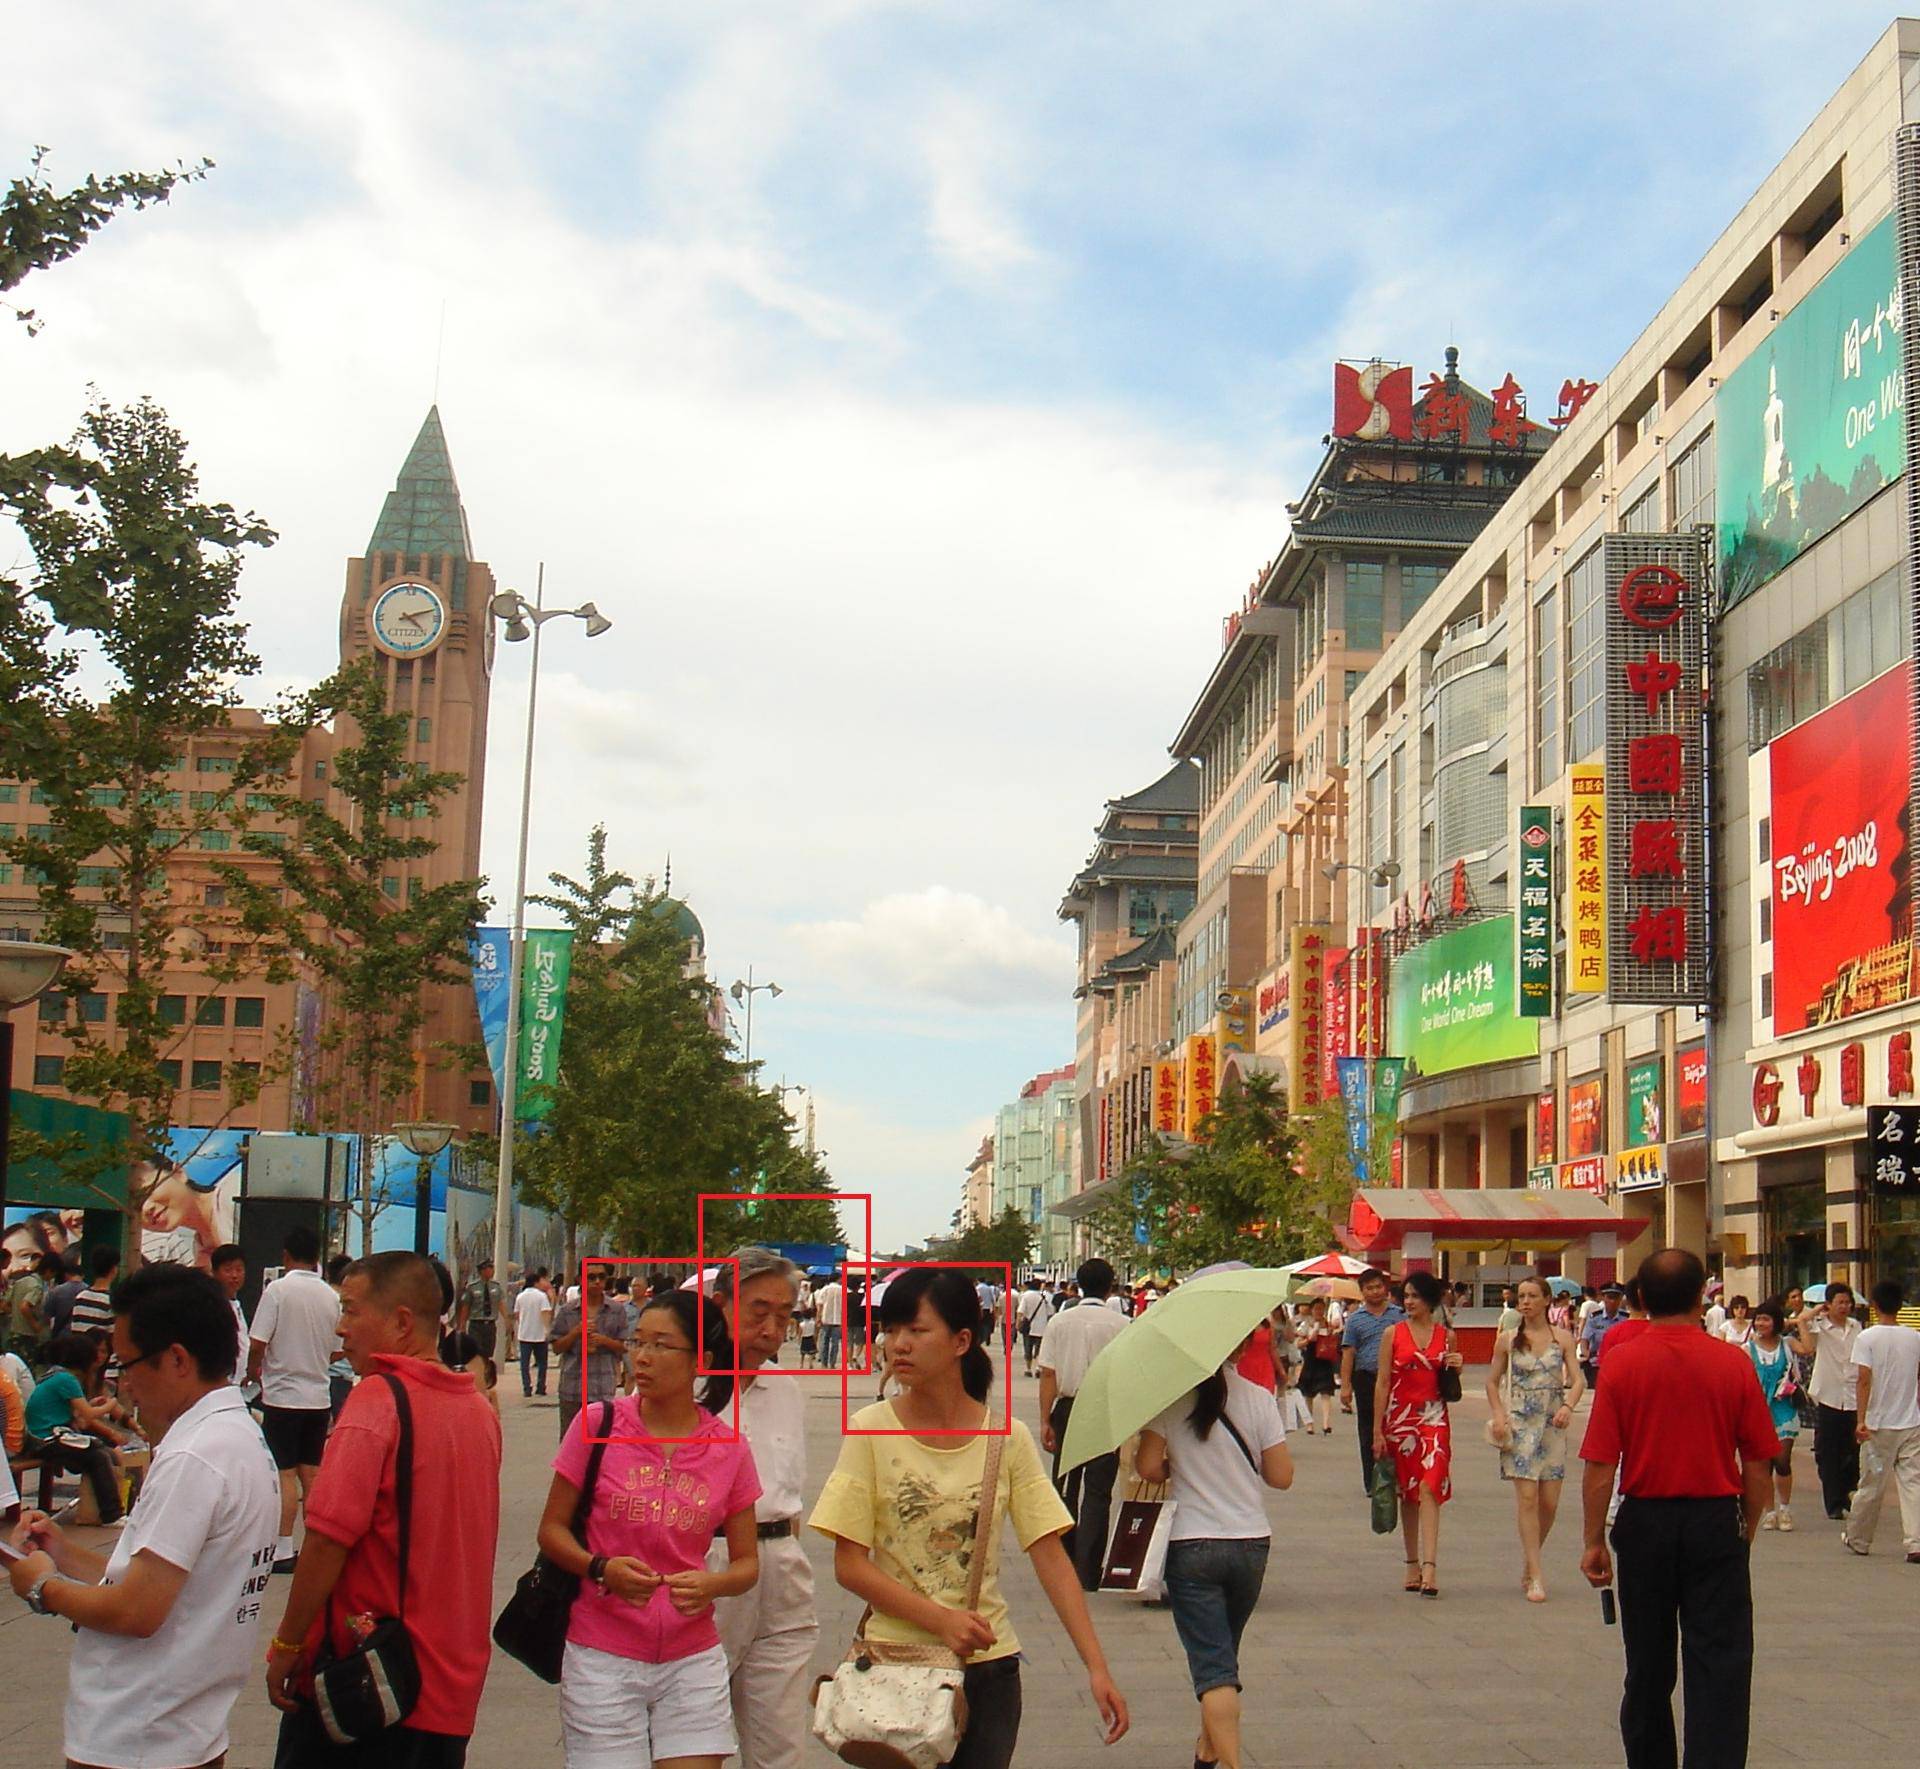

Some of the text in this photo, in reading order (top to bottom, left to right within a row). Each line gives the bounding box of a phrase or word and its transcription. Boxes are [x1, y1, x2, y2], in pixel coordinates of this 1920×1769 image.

[1845, 400, 1876, 449] One
[1576, 804, 1603, 978] 全聚德烤鸭店
[1775, 820, 1878, 906] Beijing 2008
[1522, 857, 1549, 969] 天福茗茶
[526, 943, 559, 1081] Beijing 2008
[1467, 1001, 1494, 1020] Dream
[625, 1466, 710, 1506] JEANS
